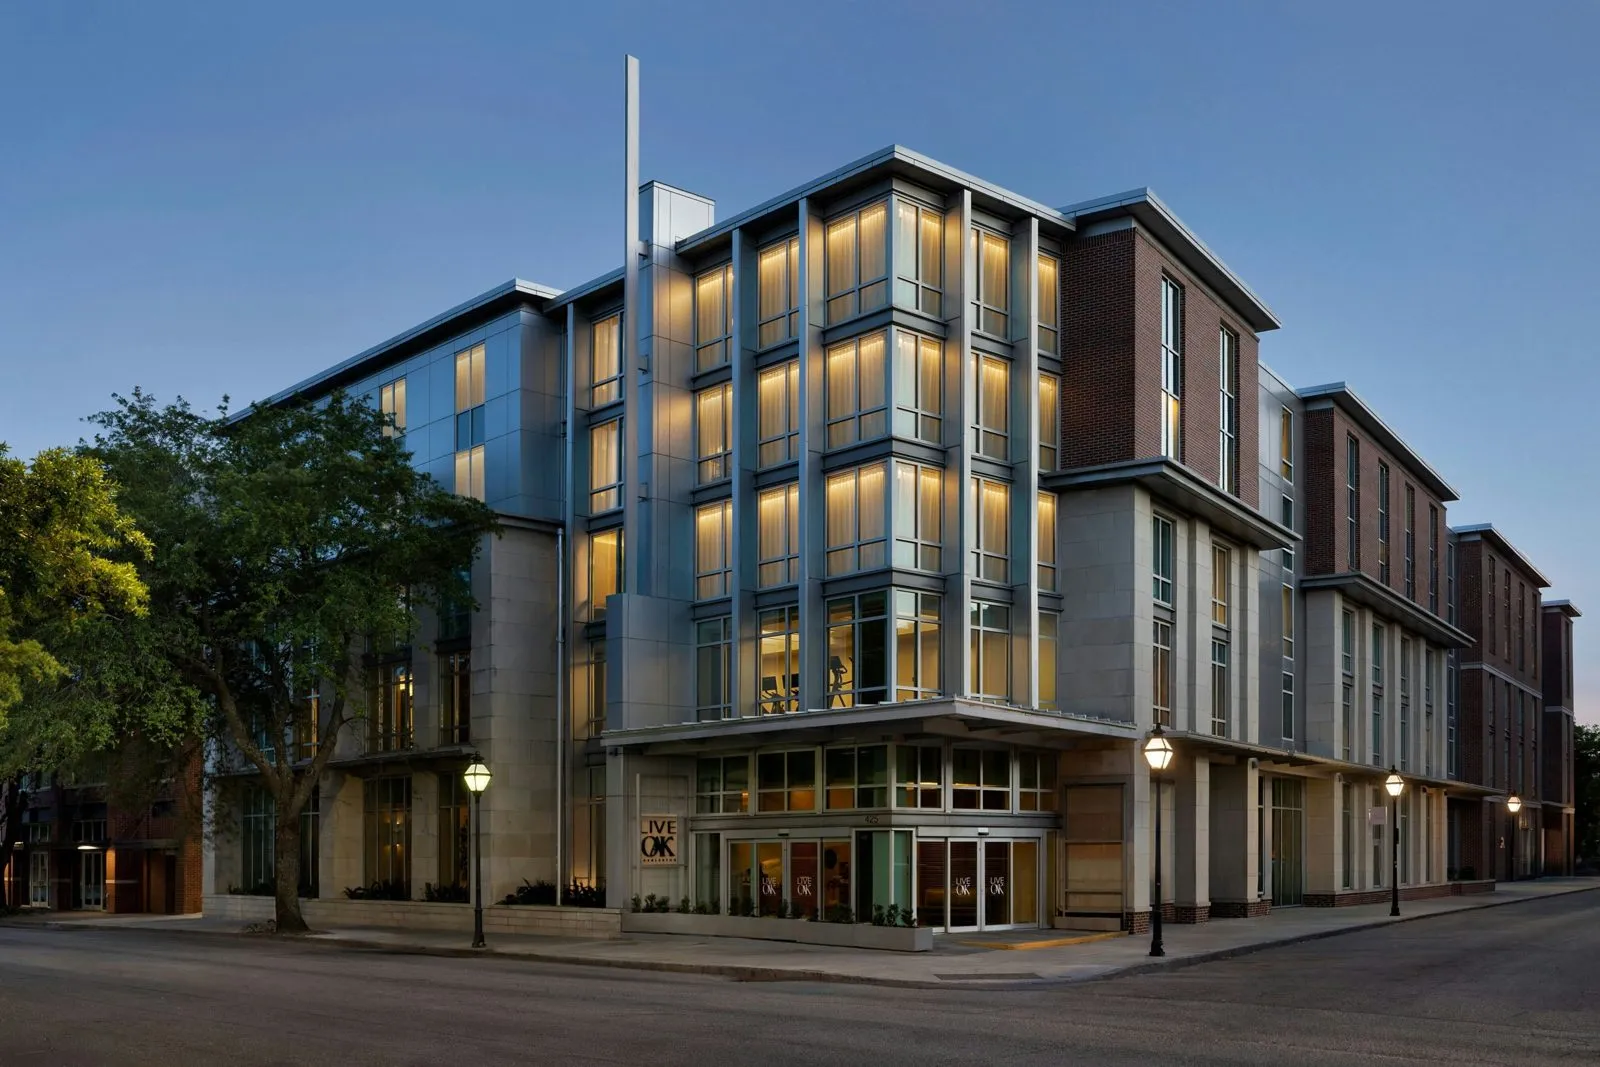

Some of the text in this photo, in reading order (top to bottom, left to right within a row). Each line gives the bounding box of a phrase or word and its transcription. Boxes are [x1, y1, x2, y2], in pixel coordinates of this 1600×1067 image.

[641, 820, 676, 834] LIVE
[762, 876, 776, 884] LIVE
[796, 876, 811, 884] LIVE
[956, 877, 971, 885] LIVE
[990, 877, 1004, 885] LIVE
